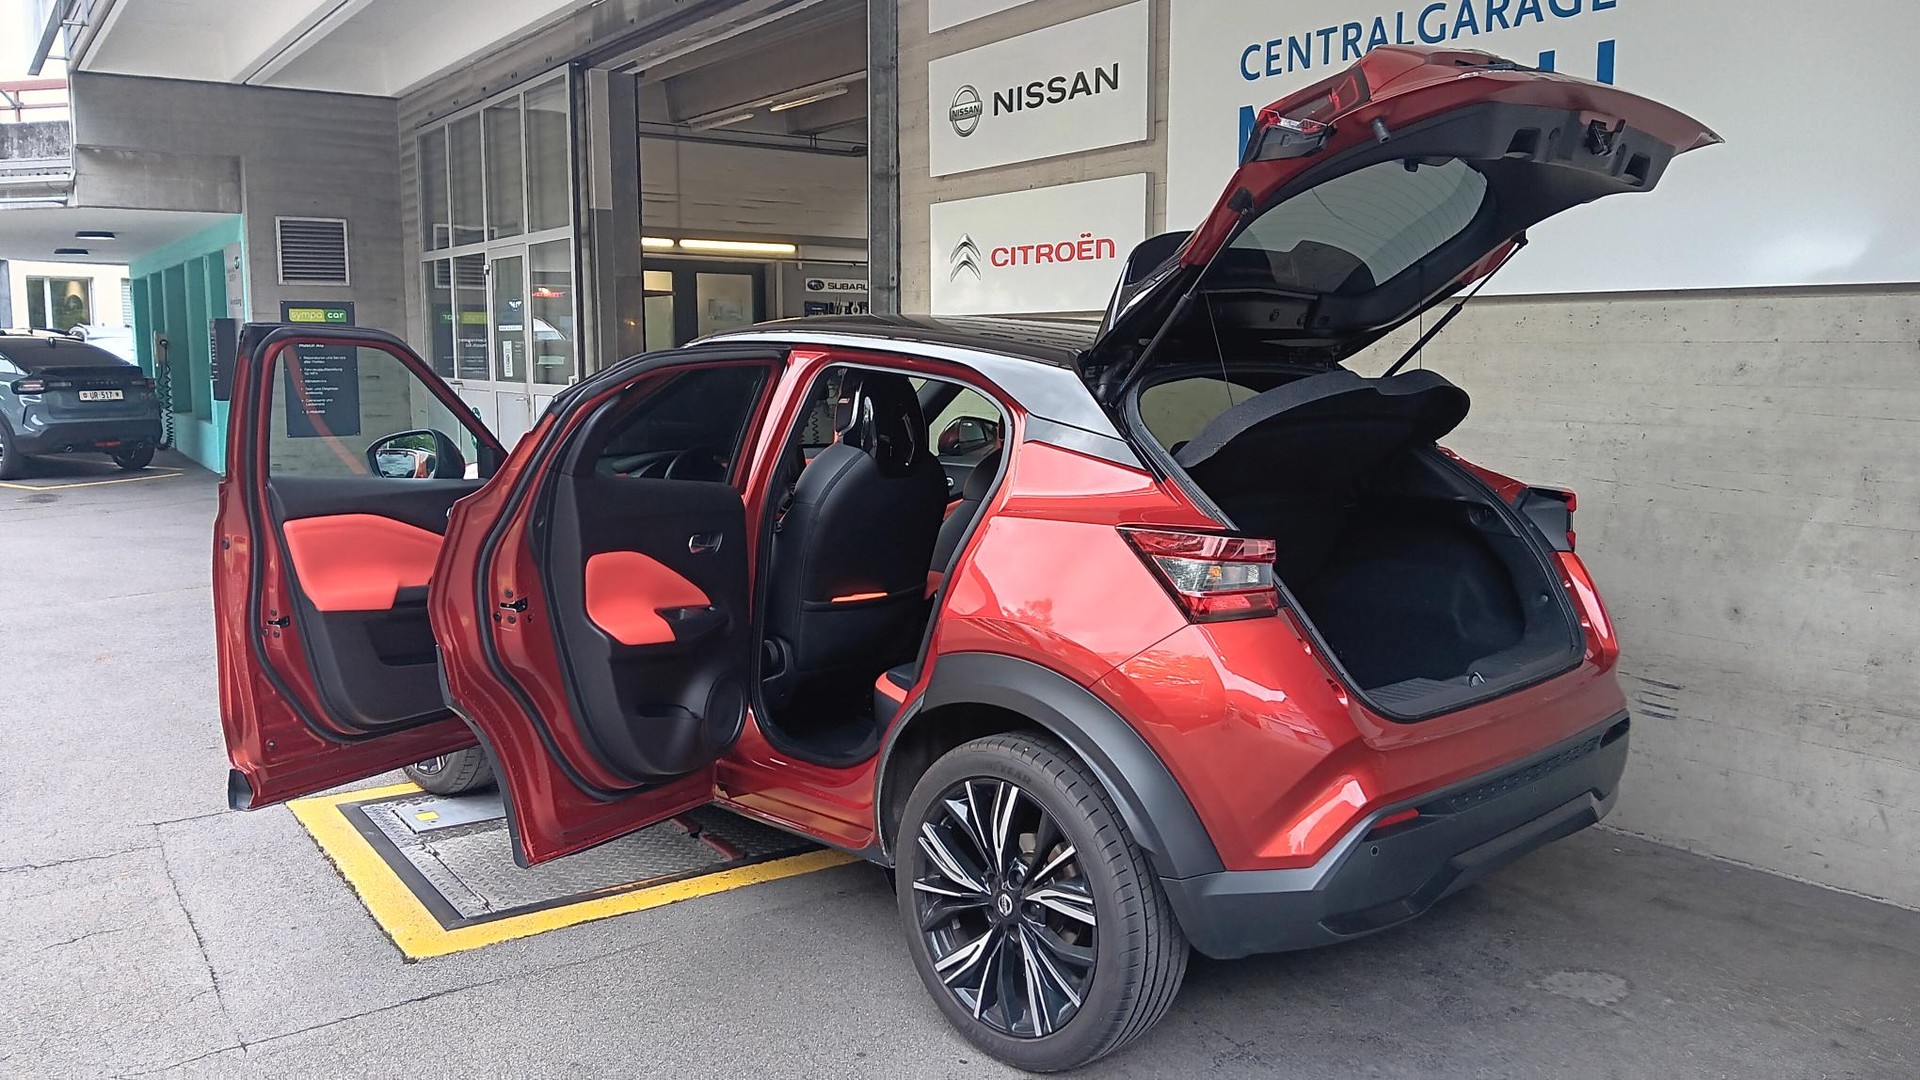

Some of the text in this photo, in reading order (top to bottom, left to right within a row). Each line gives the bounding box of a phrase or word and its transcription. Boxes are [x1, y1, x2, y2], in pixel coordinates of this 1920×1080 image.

[1240, 0, 1617, 81] CENTRALGARA
[993, 62, 1120, 117] NISSAN
[89, 391, 113, 400] UR 517
